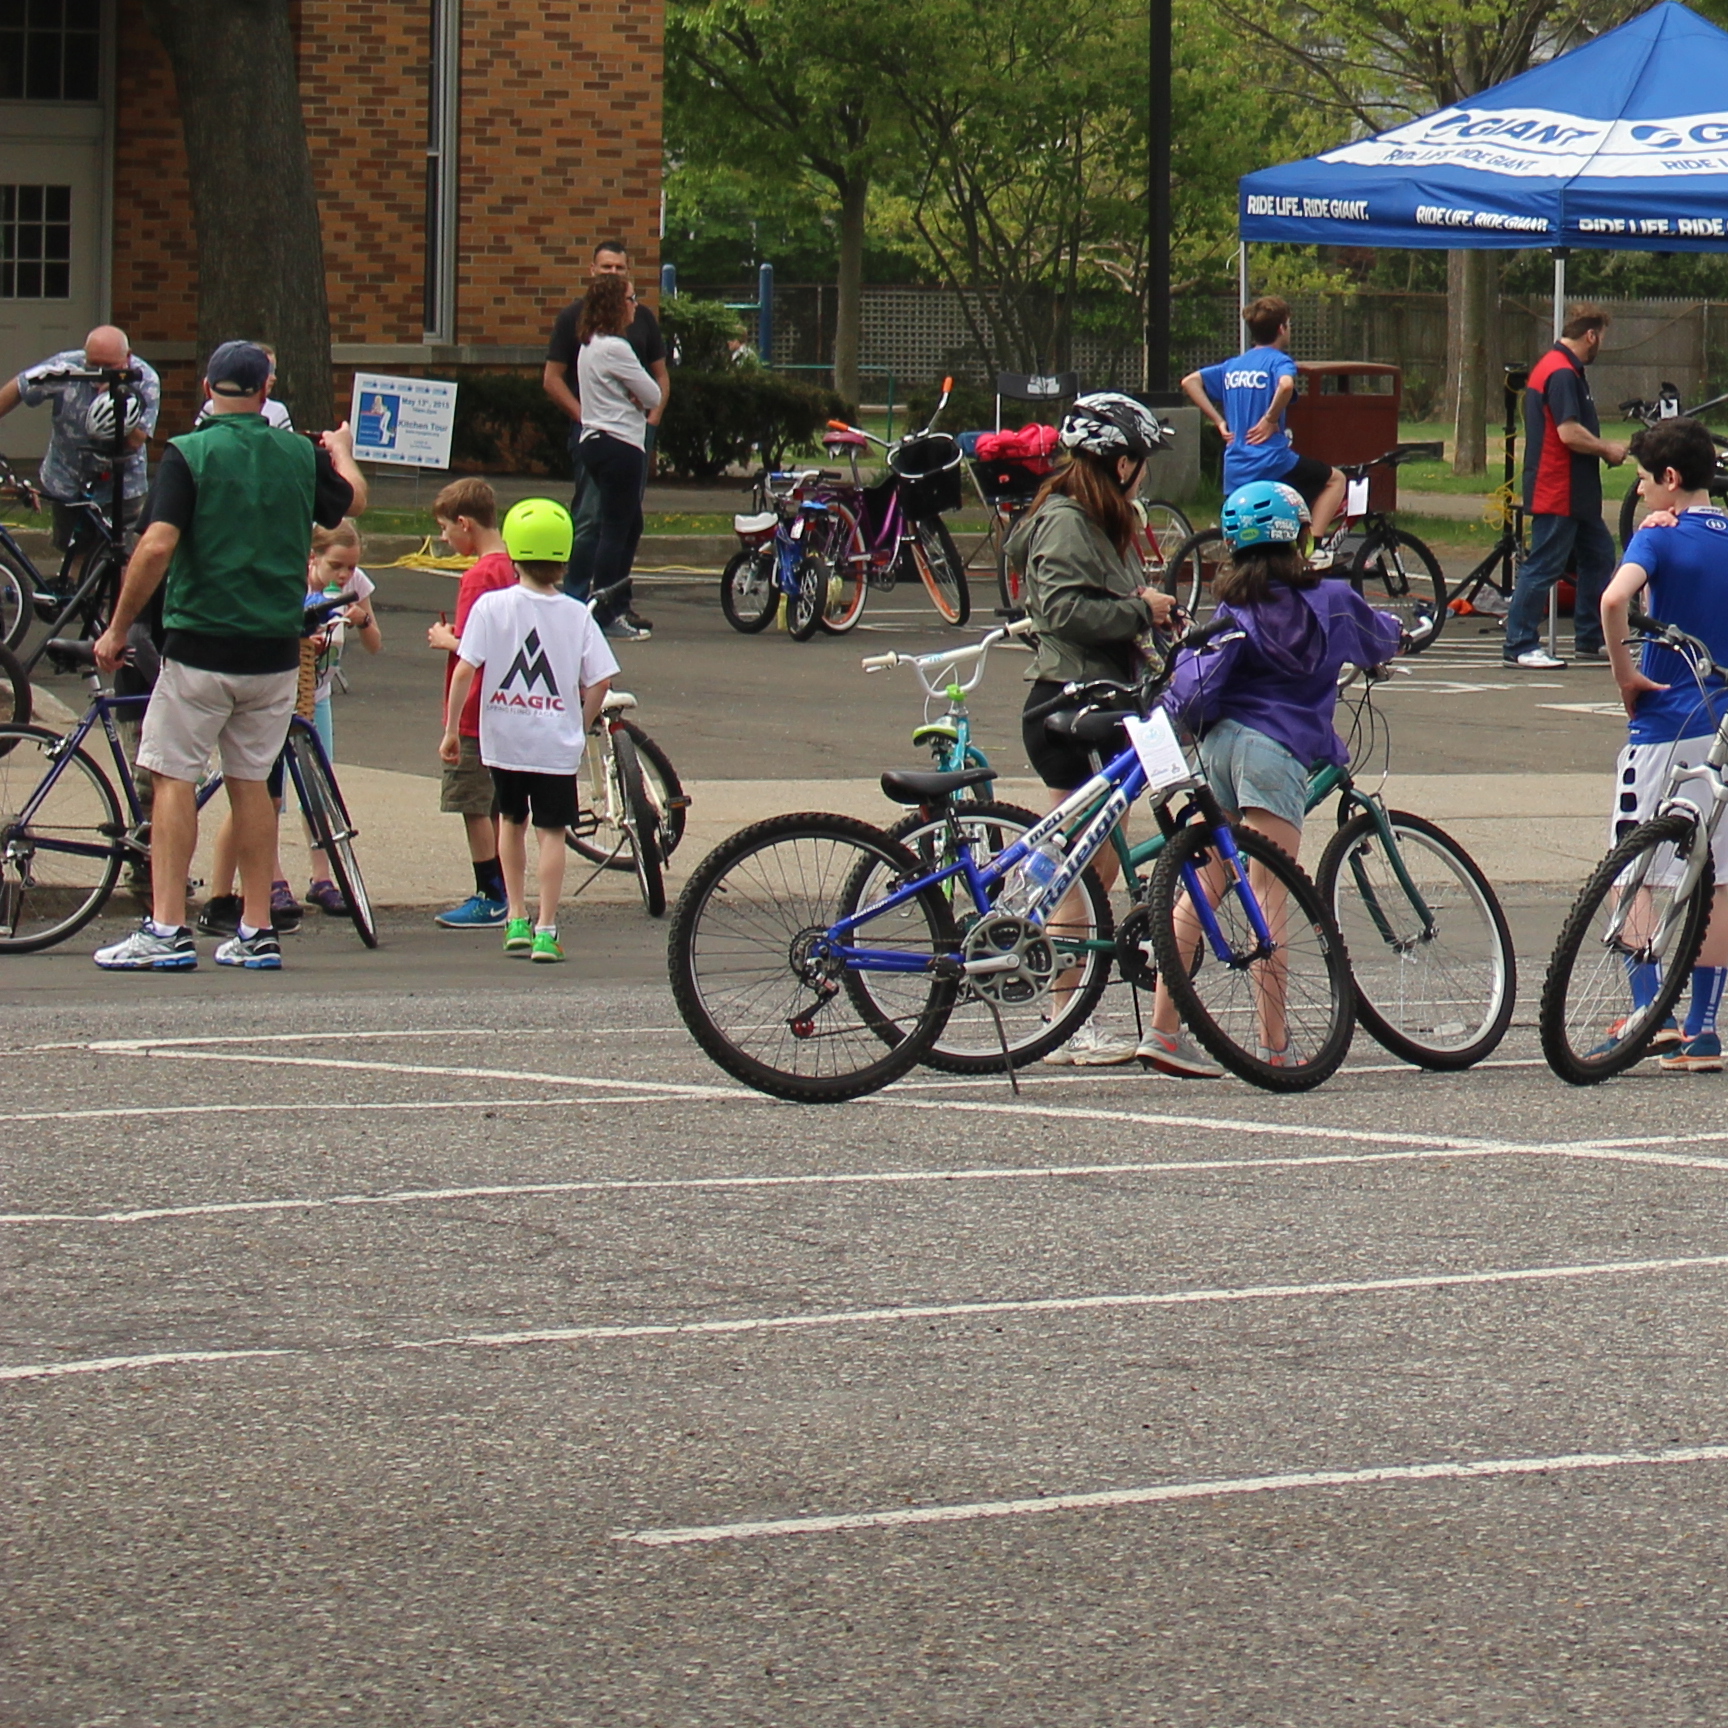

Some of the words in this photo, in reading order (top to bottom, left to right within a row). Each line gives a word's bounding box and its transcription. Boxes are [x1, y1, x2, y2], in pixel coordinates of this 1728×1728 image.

[1467, 117, 1601, 147] GIANT
[1661, 159, 1715, 170] RIDE
[1248, 195, 1274, 215] RIDE
[1275, 196, 1303, 216] LIFE.
[1304, 198, 1328, 217] RIDE
[1329, 199, 1369, 220] GIANT.
[1416, 205, 1445, 225] RIDE
[1446, 209, 1473, 227] LIFE.
[1474, 211, 1504, 229] RIDE
[1579, 218, 1625, 233] RIDE
[1629, 218, 1676, 236] LIFE.
[1677, 218, 1725, 236] RIDE
[402, 398, 416, 407] May
[398, 419, 428, 430] Kitchen
[431, 423, 447, 432] Tour
[489, 691, 566, 712] MAGIC
[1040, 795, 1127, 913] Raleigh
